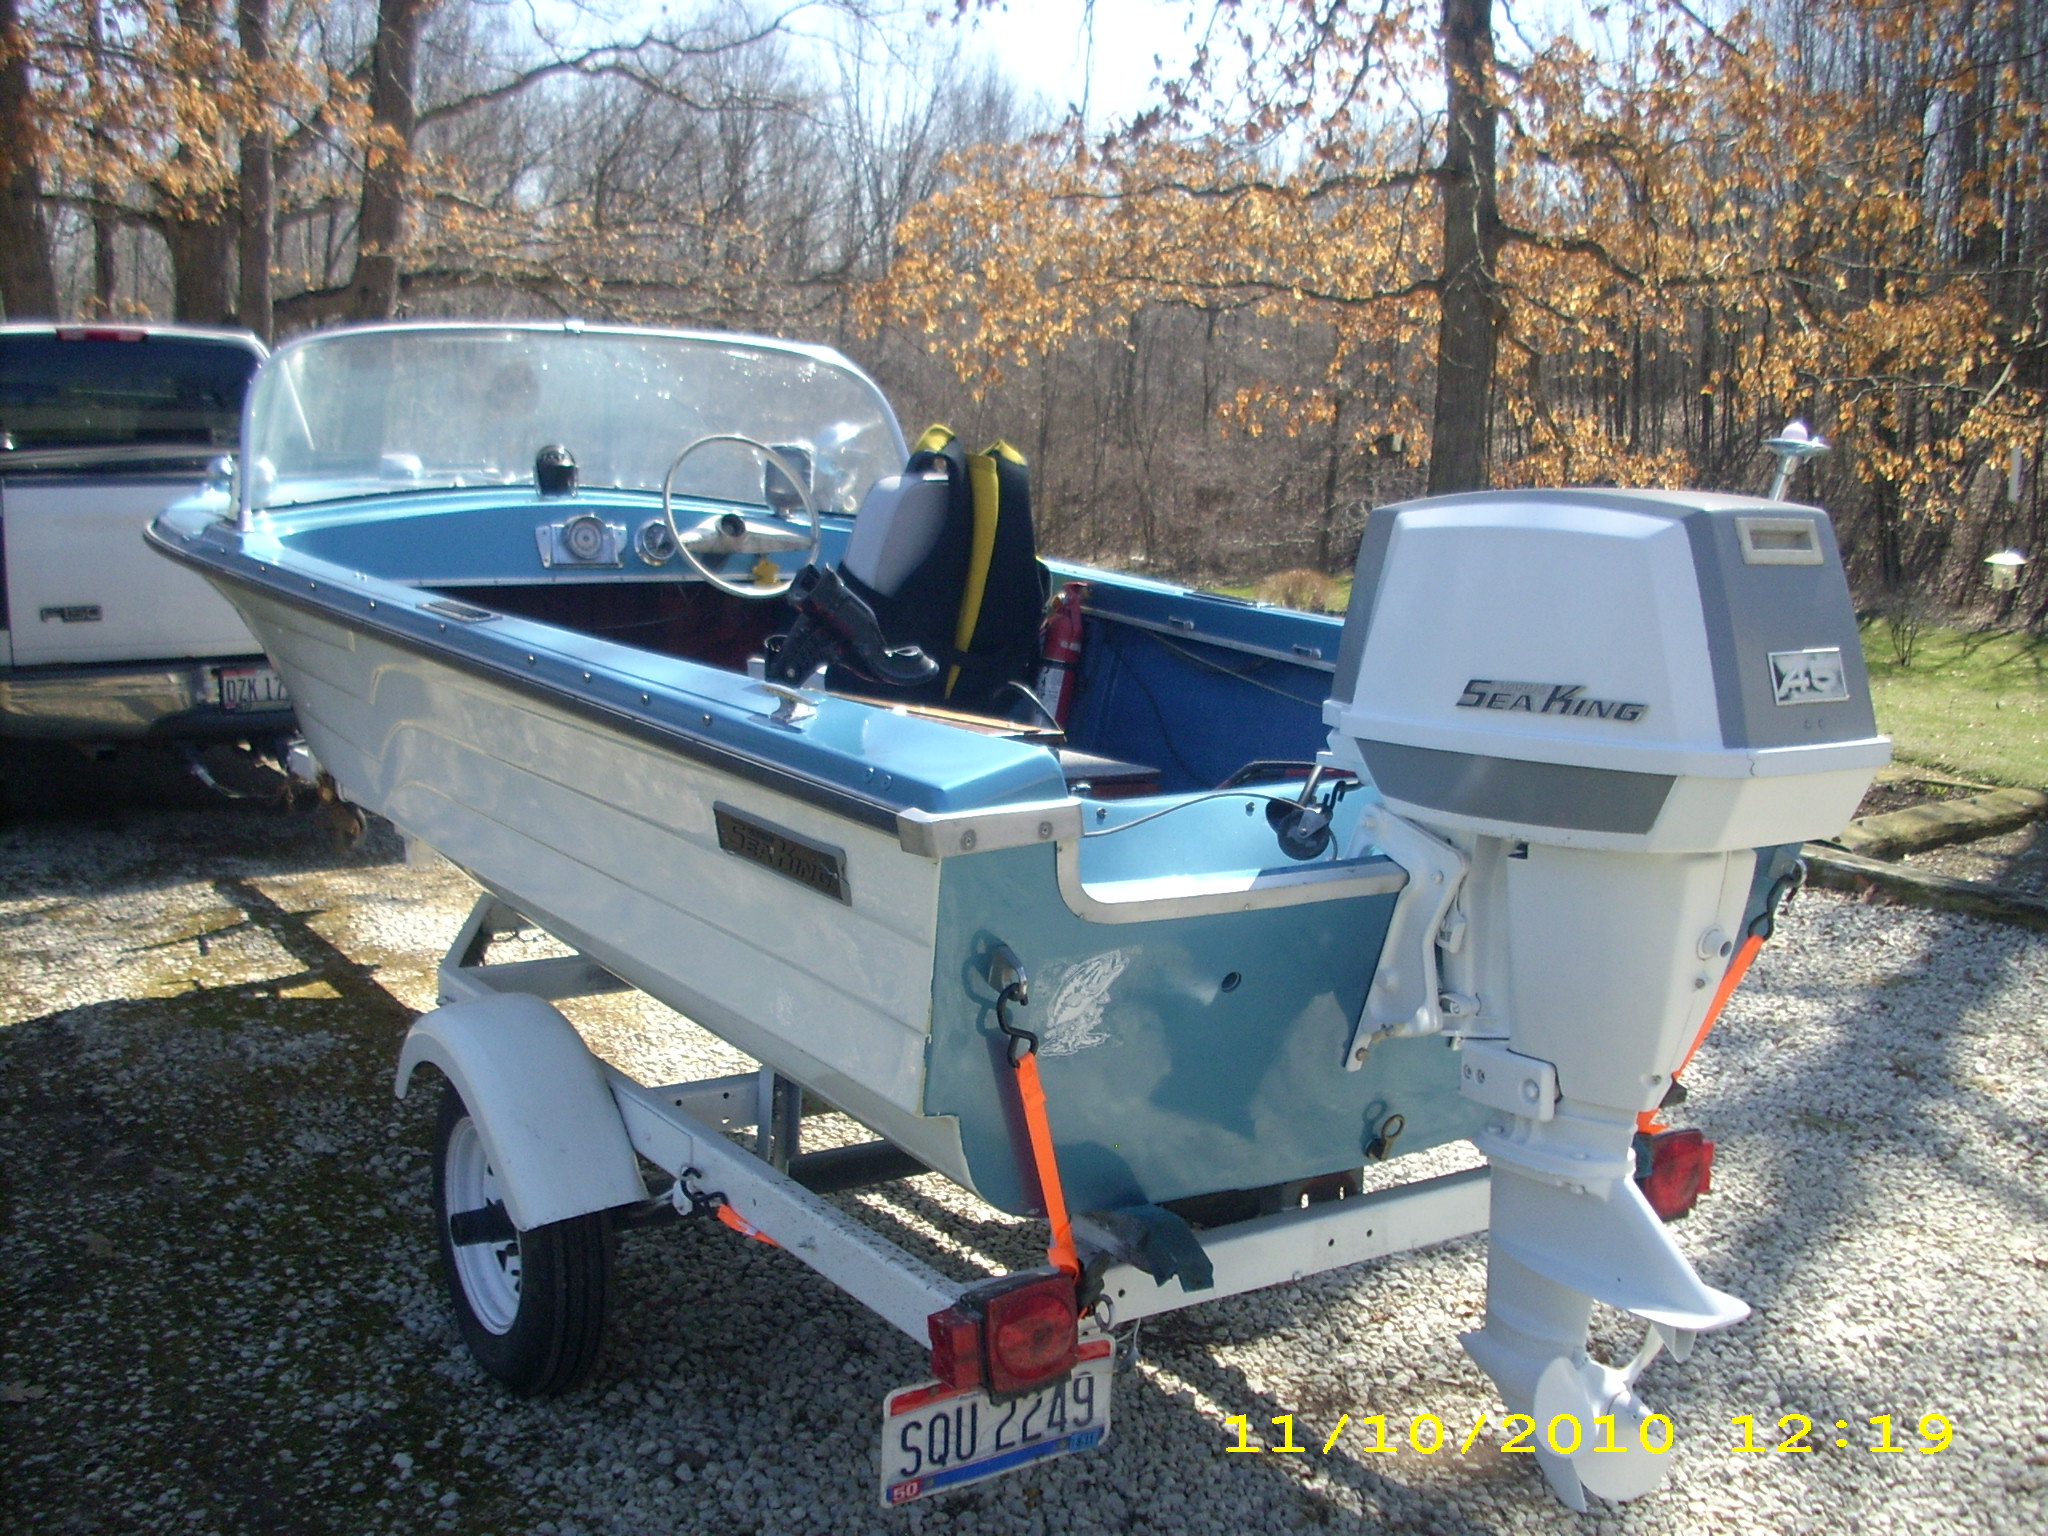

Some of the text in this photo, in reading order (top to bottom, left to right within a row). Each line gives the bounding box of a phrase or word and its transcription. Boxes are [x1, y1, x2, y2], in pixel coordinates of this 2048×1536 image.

[900, 1371, 1095, 1477] SQU 2249
[893, 1482, 919, 1499] 50
